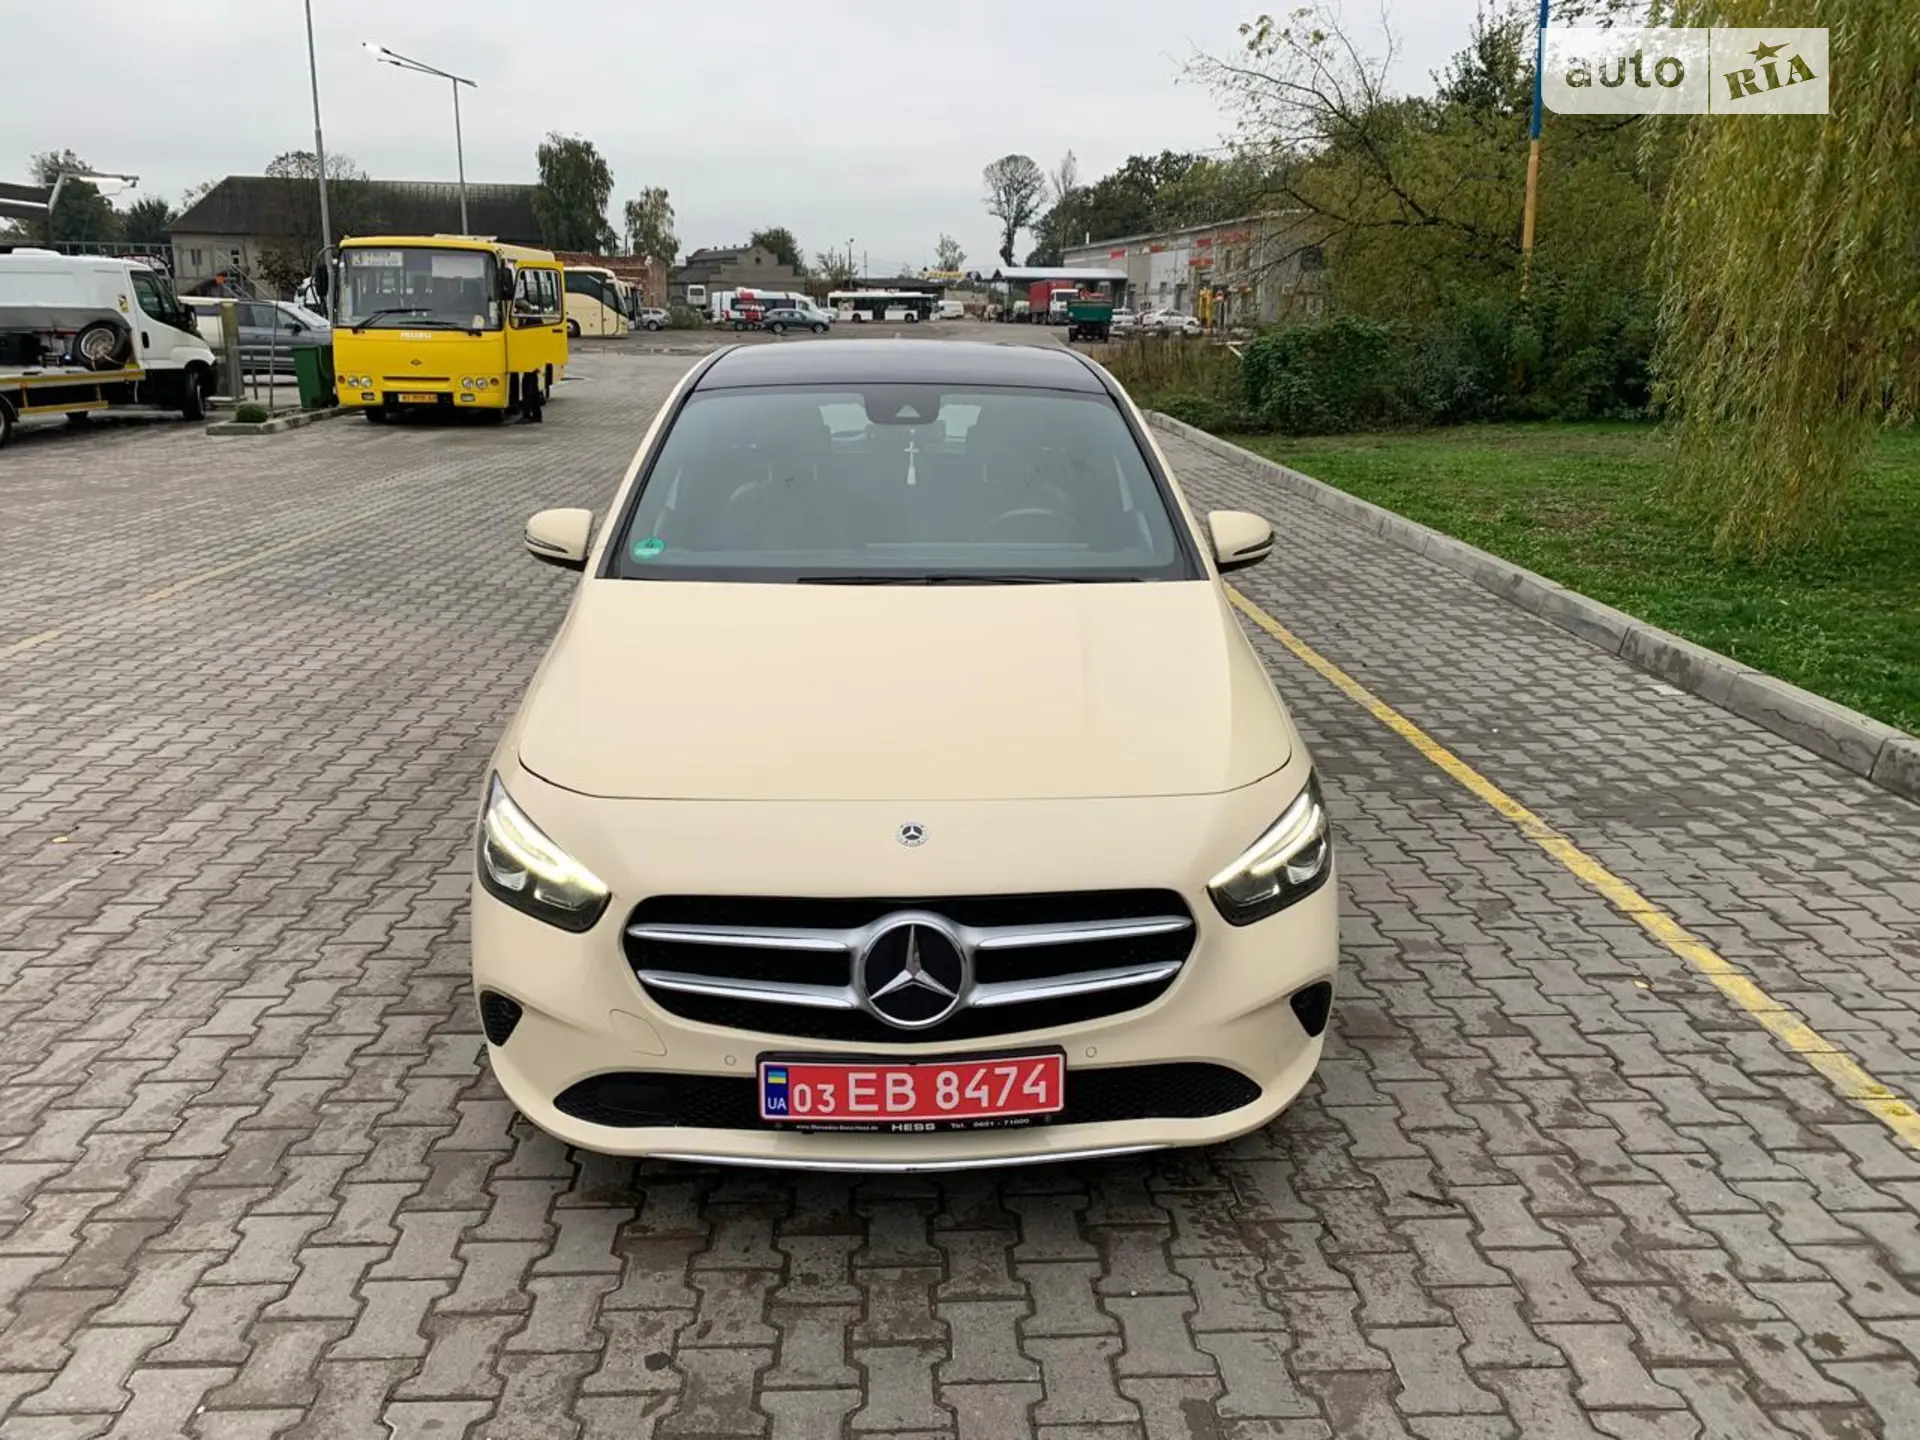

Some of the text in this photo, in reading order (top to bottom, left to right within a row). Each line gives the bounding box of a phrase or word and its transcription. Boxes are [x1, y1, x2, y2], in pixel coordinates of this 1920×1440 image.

[792, 1063, 1047, 1113] 03 EB 8474
[767, 1097, 787, 1110] UA
[891, 1122, 936, 1132] HESS
